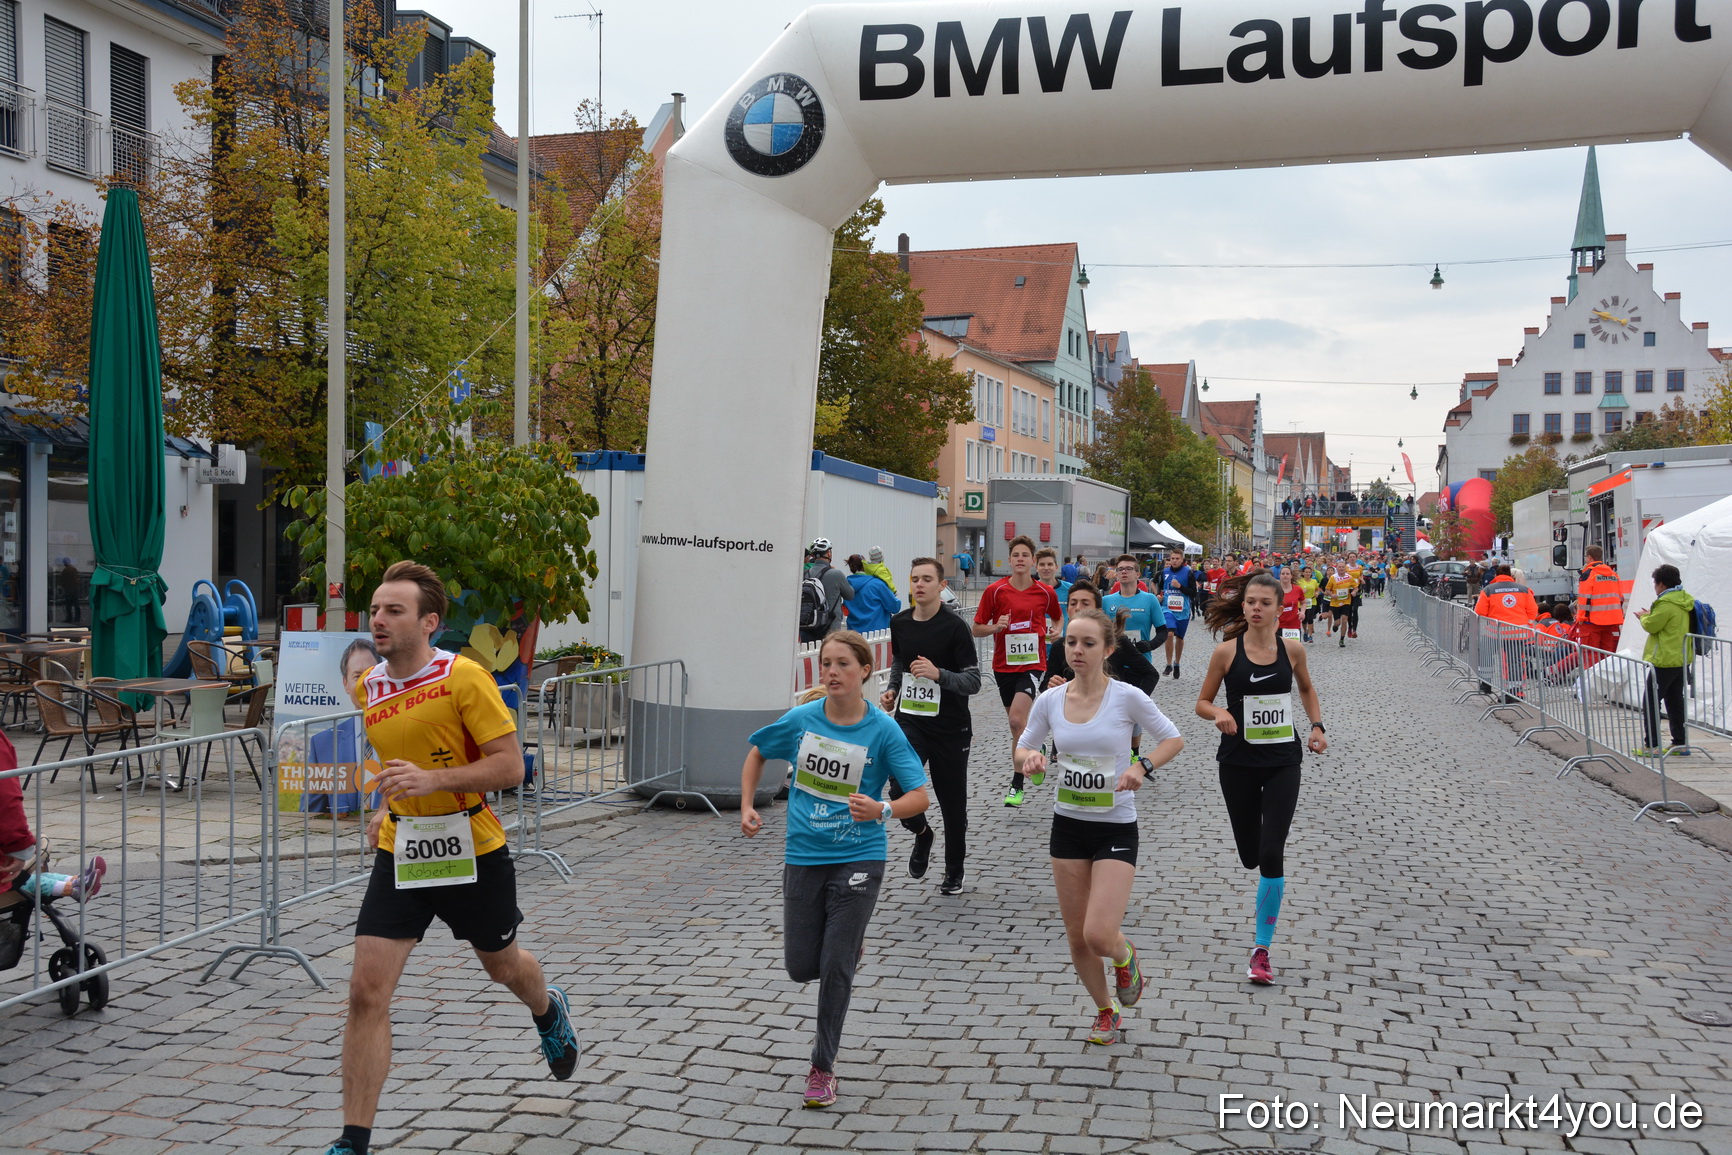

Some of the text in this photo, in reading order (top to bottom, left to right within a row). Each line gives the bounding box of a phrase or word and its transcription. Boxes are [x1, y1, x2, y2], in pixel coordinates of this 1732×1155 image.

[858, 10, 1133, 101] BMW
[202, 468, 213, 476] Hut
[220, 468, 235, 477] Mode
[968, 494, 981, 508] D
[1335, 518, 1353, 526] ZIEL
[641, 533, 774, 552] www.bmw-laufsport.de
[1010, 642, 1034, 653] 5114
[285, 682, 328, 694] WEITER.
[906, 686, 934, 700] 5134
[284, 694, 340, 706] MACHEN.
[365, 684, 452, 728] MAX BÖGL
[1252, 708, 1285, 726] 5001
[281, 765, 347, 779] THOMAS
[805, 752, 851, 780] 5091
[812, 778, 838, 791] Luciana
[1064, 769, 1105, 789] 5000
[1071, 793, 1096, 802] Vanessa
[405, 836, 462, 860] 5008
[405, 861, 456, 880] Robert
[852, 872, 869, 880] NIKE
